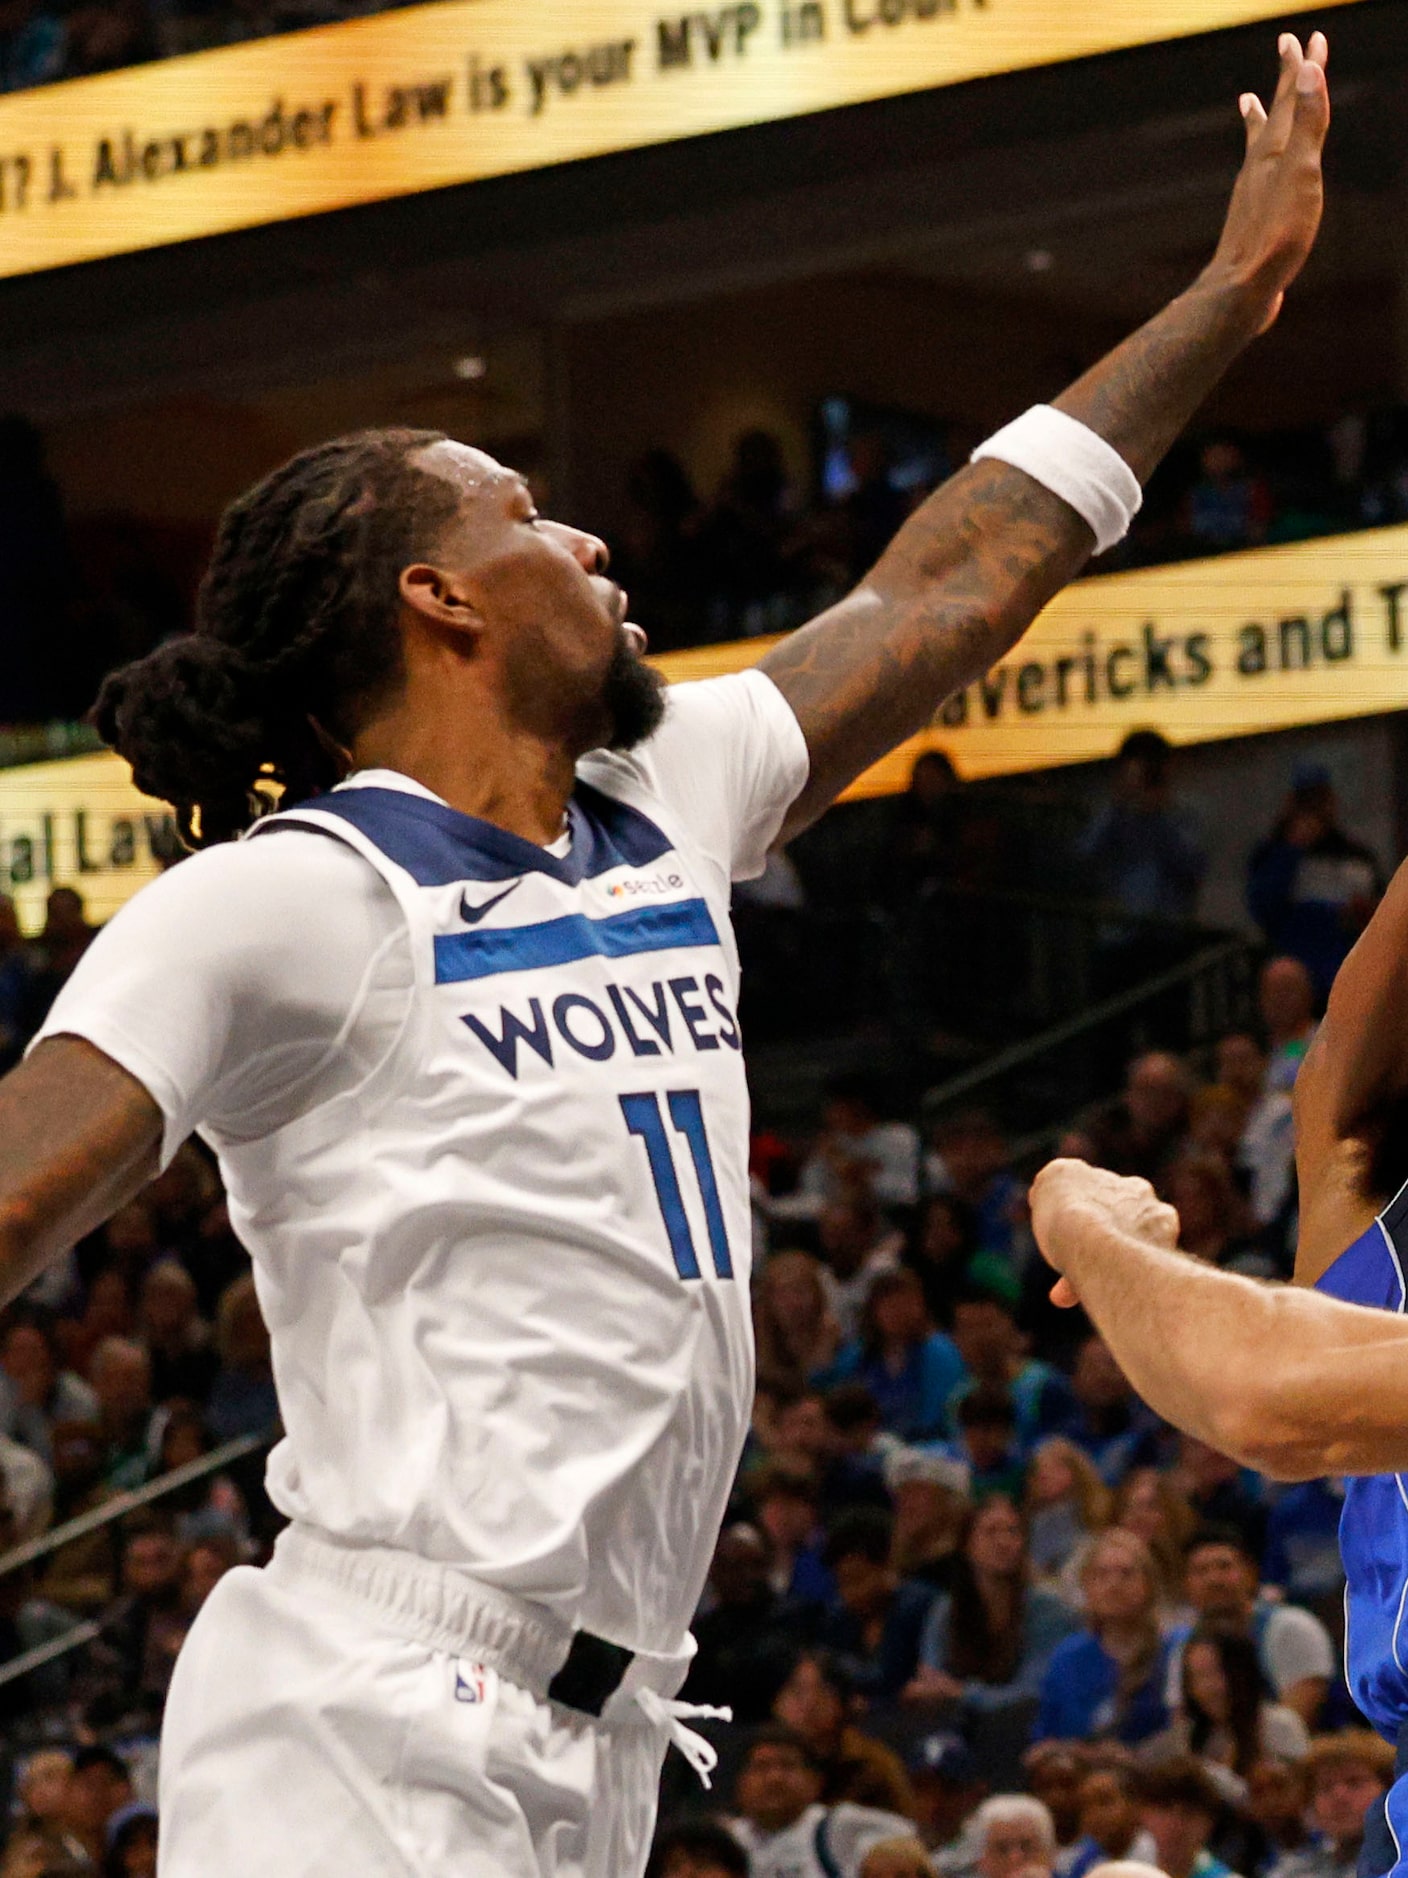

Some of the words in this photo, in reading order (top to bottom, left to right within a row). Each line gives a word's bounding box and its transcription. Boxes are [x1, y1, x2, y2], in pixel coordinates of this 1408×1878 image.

[92, 96, 337, 189] Alexander
[353, 77, 452, 139] Law
[469, 54, 509, 114] is
[524, 37, 635, 118] your
[657, 3, 758, 71] MVP
[780, 0, 824, 51] in
[938, 621, 1212, 728] avericks
[1236, 584, 1353, 676] and
[9, 808, 53, 883] al
[458, 973, 744, 1081] WOLVES
[617, 1088, 735, 1281] 11
